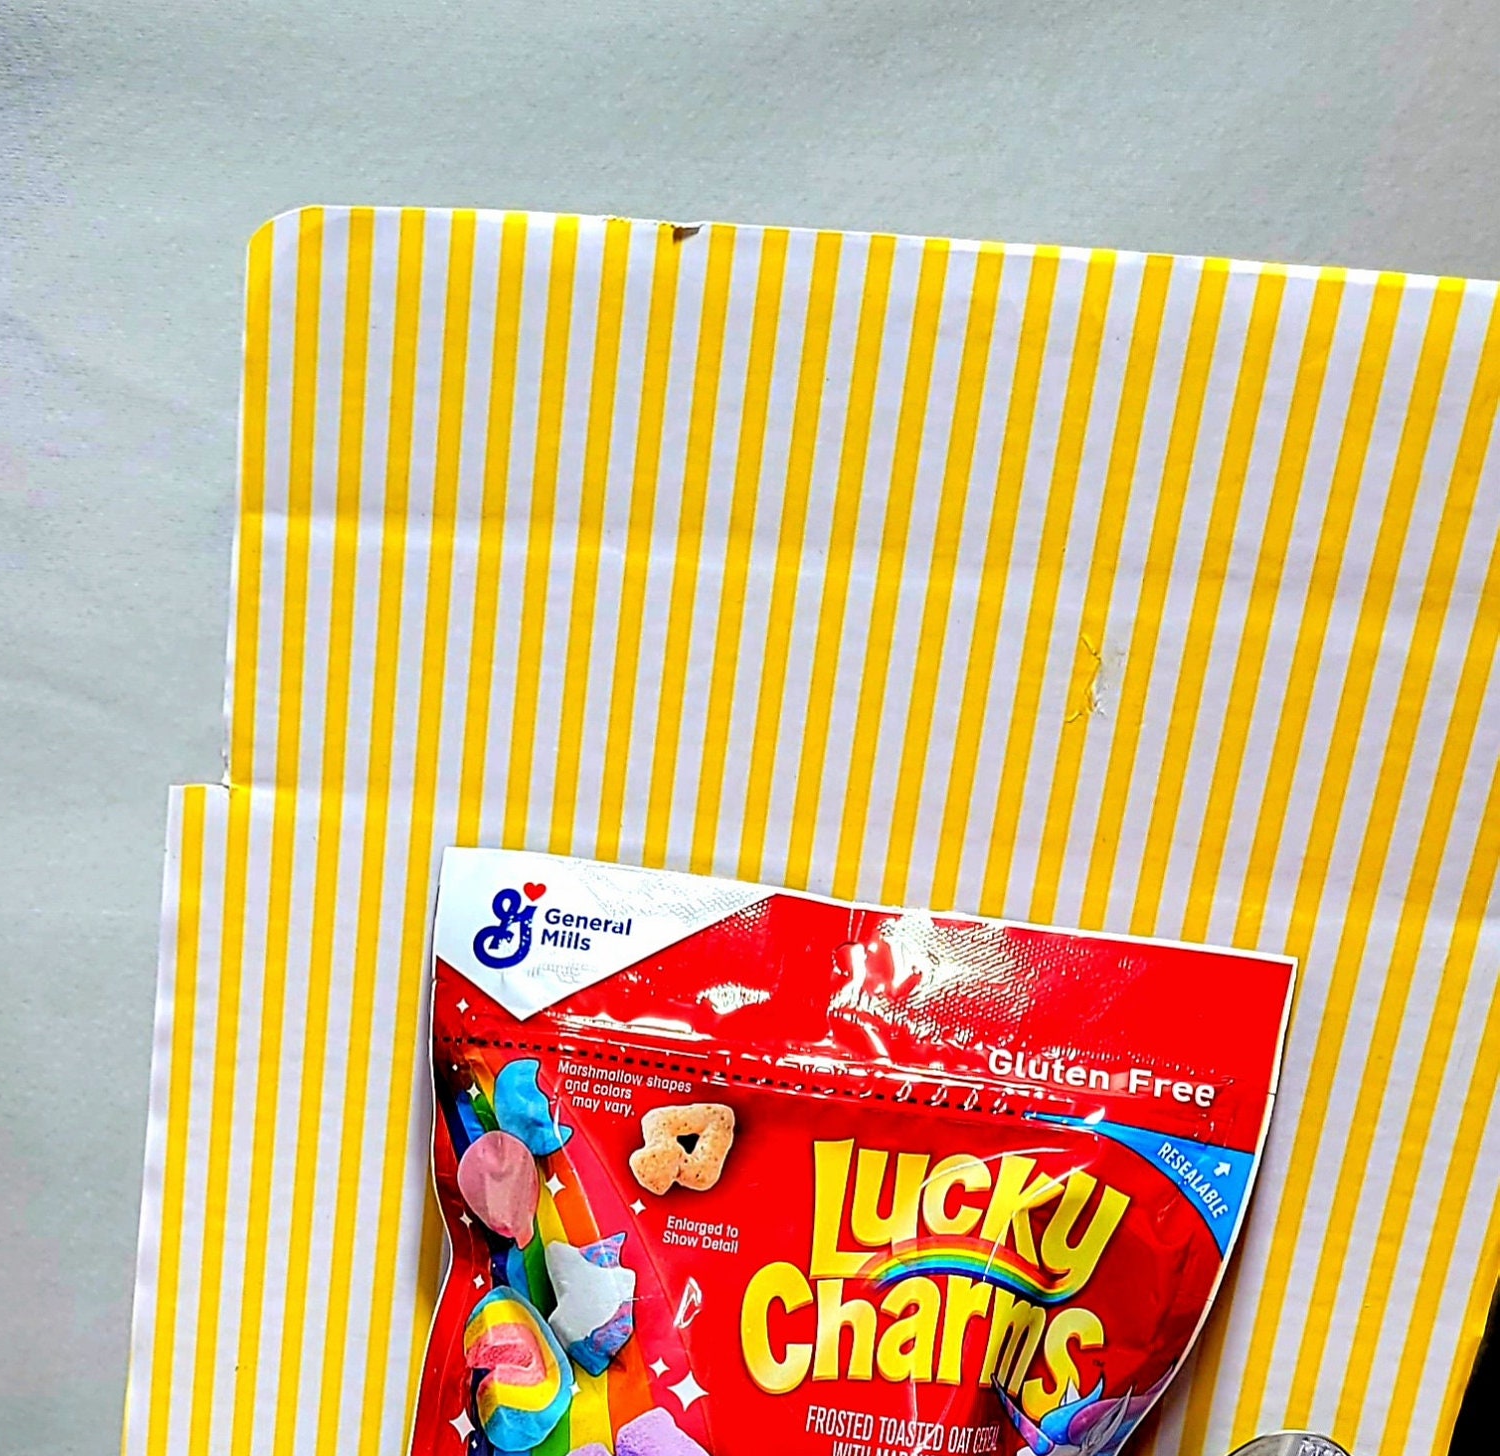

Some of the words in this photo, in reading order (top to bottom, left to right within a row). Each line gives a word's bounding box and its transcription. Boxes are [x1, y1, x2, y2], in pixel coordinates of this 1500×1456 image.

[544, 908, 633, 936] General
[540, 928, 592, 951] Mills
[557, 1060, 643, 1087] Marshmallow
[646, 1075, 693, 1094] shapes
[565, 1078, 589, 1092] and
[592, 1081, 632, 1100] colors
[988, 1048, 1110, 1091] Gluten
[1128, 1067, 1216, 1108] Free
[572, 1095, 600, 1112] may
[604, 1100, 635, 1118] vary.
[1157, 1141, 1230, 1219] RESEALABLE
[667, 1215, 724, 1236] Enlarged
[726, 1225, 739, 1238] to
[809, 1138, 1131, 1290] Lucky
[662, 1230, 698, 1248] Show
[702, 1236, 739, 1254] Detail
[740, 1261, 1104, 1422] Charms
[805, 1405, 874, 1441] FROSTED
[877, 1416, 945, 1451] TOASTED
[947, 1425, 974, 1454] OAT
